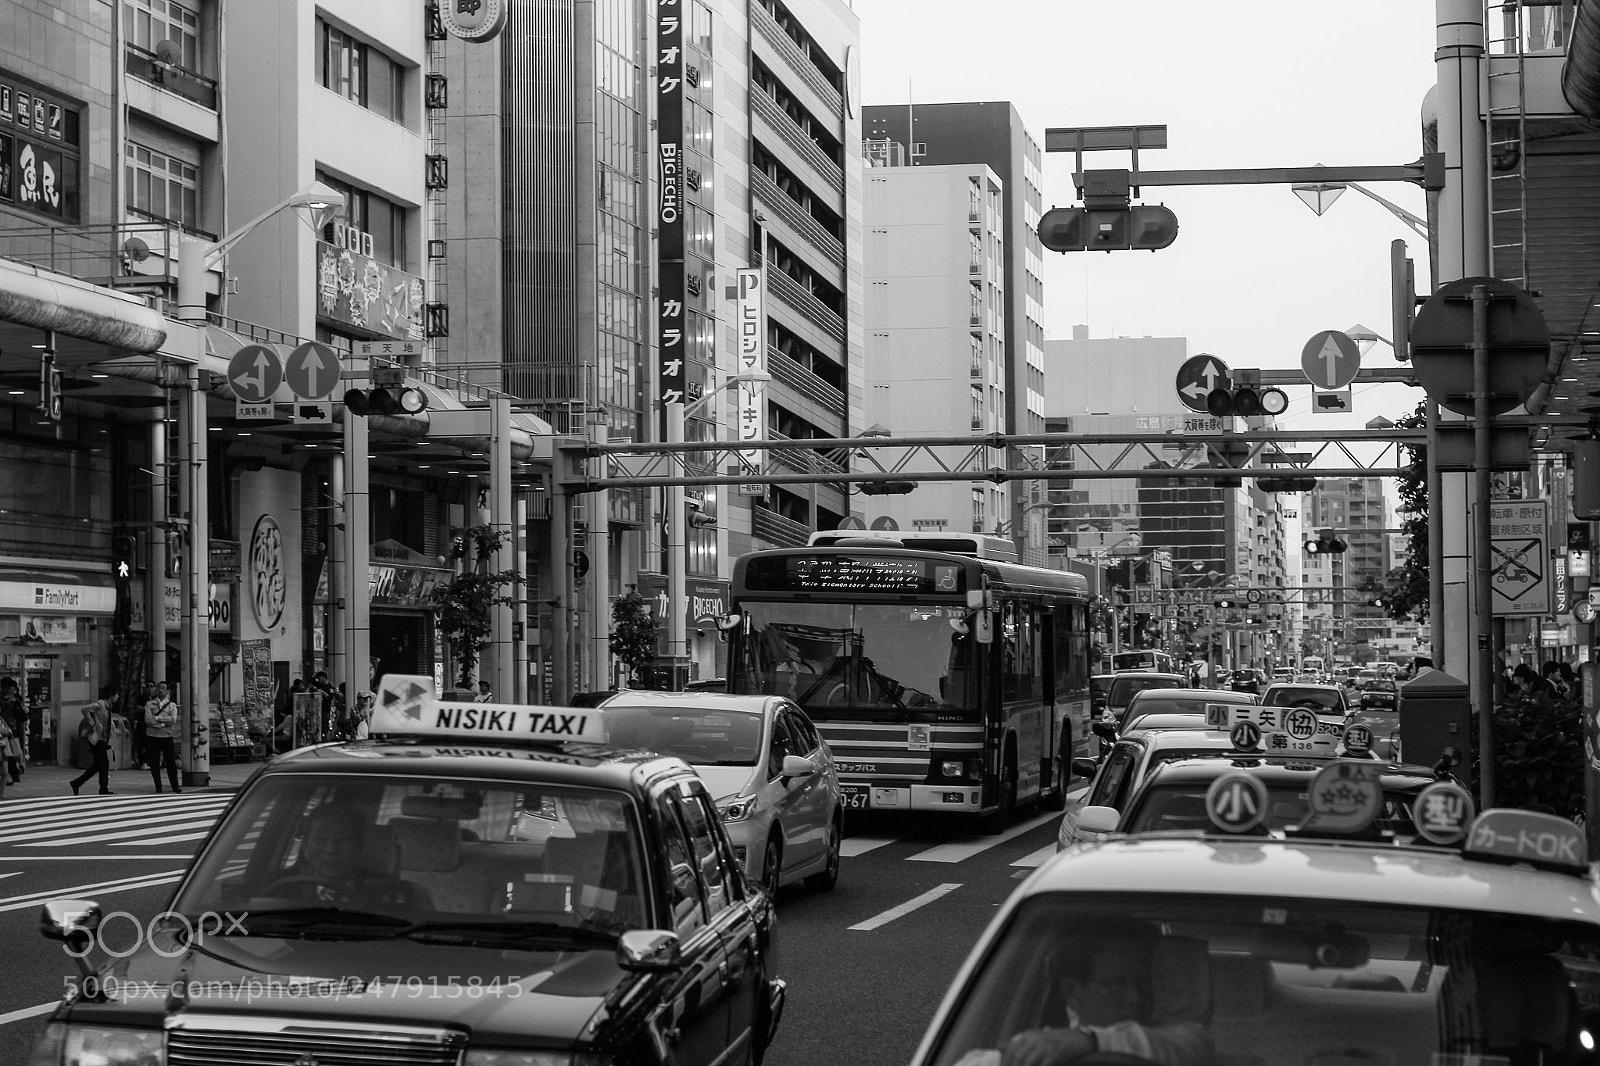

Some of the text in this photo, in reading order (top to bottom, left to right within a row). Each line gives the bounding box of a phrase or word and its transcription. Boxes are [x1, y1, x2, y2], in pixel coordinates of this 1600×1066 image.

[20, 143, 60, 208] 魚民
[361, 343, 414, 354] 新天地
[661, 299, 684, 407] カラオケ
[1184, 418, 1221, 431] 大貨等を除く
[45, 588, 79, 607] FamilyMart
[436, 708, 587, 736] NISIKI TAXI
[1289, 713, 1314, 737] 協
[1234, 724, 1257, 746] 小
[1292, 741, 1313, 750] 136
[1347, 730, 1370, 751] 型
[1215, 783, 1257, 822] 小
[1424, 795, 1464, 832] 型
